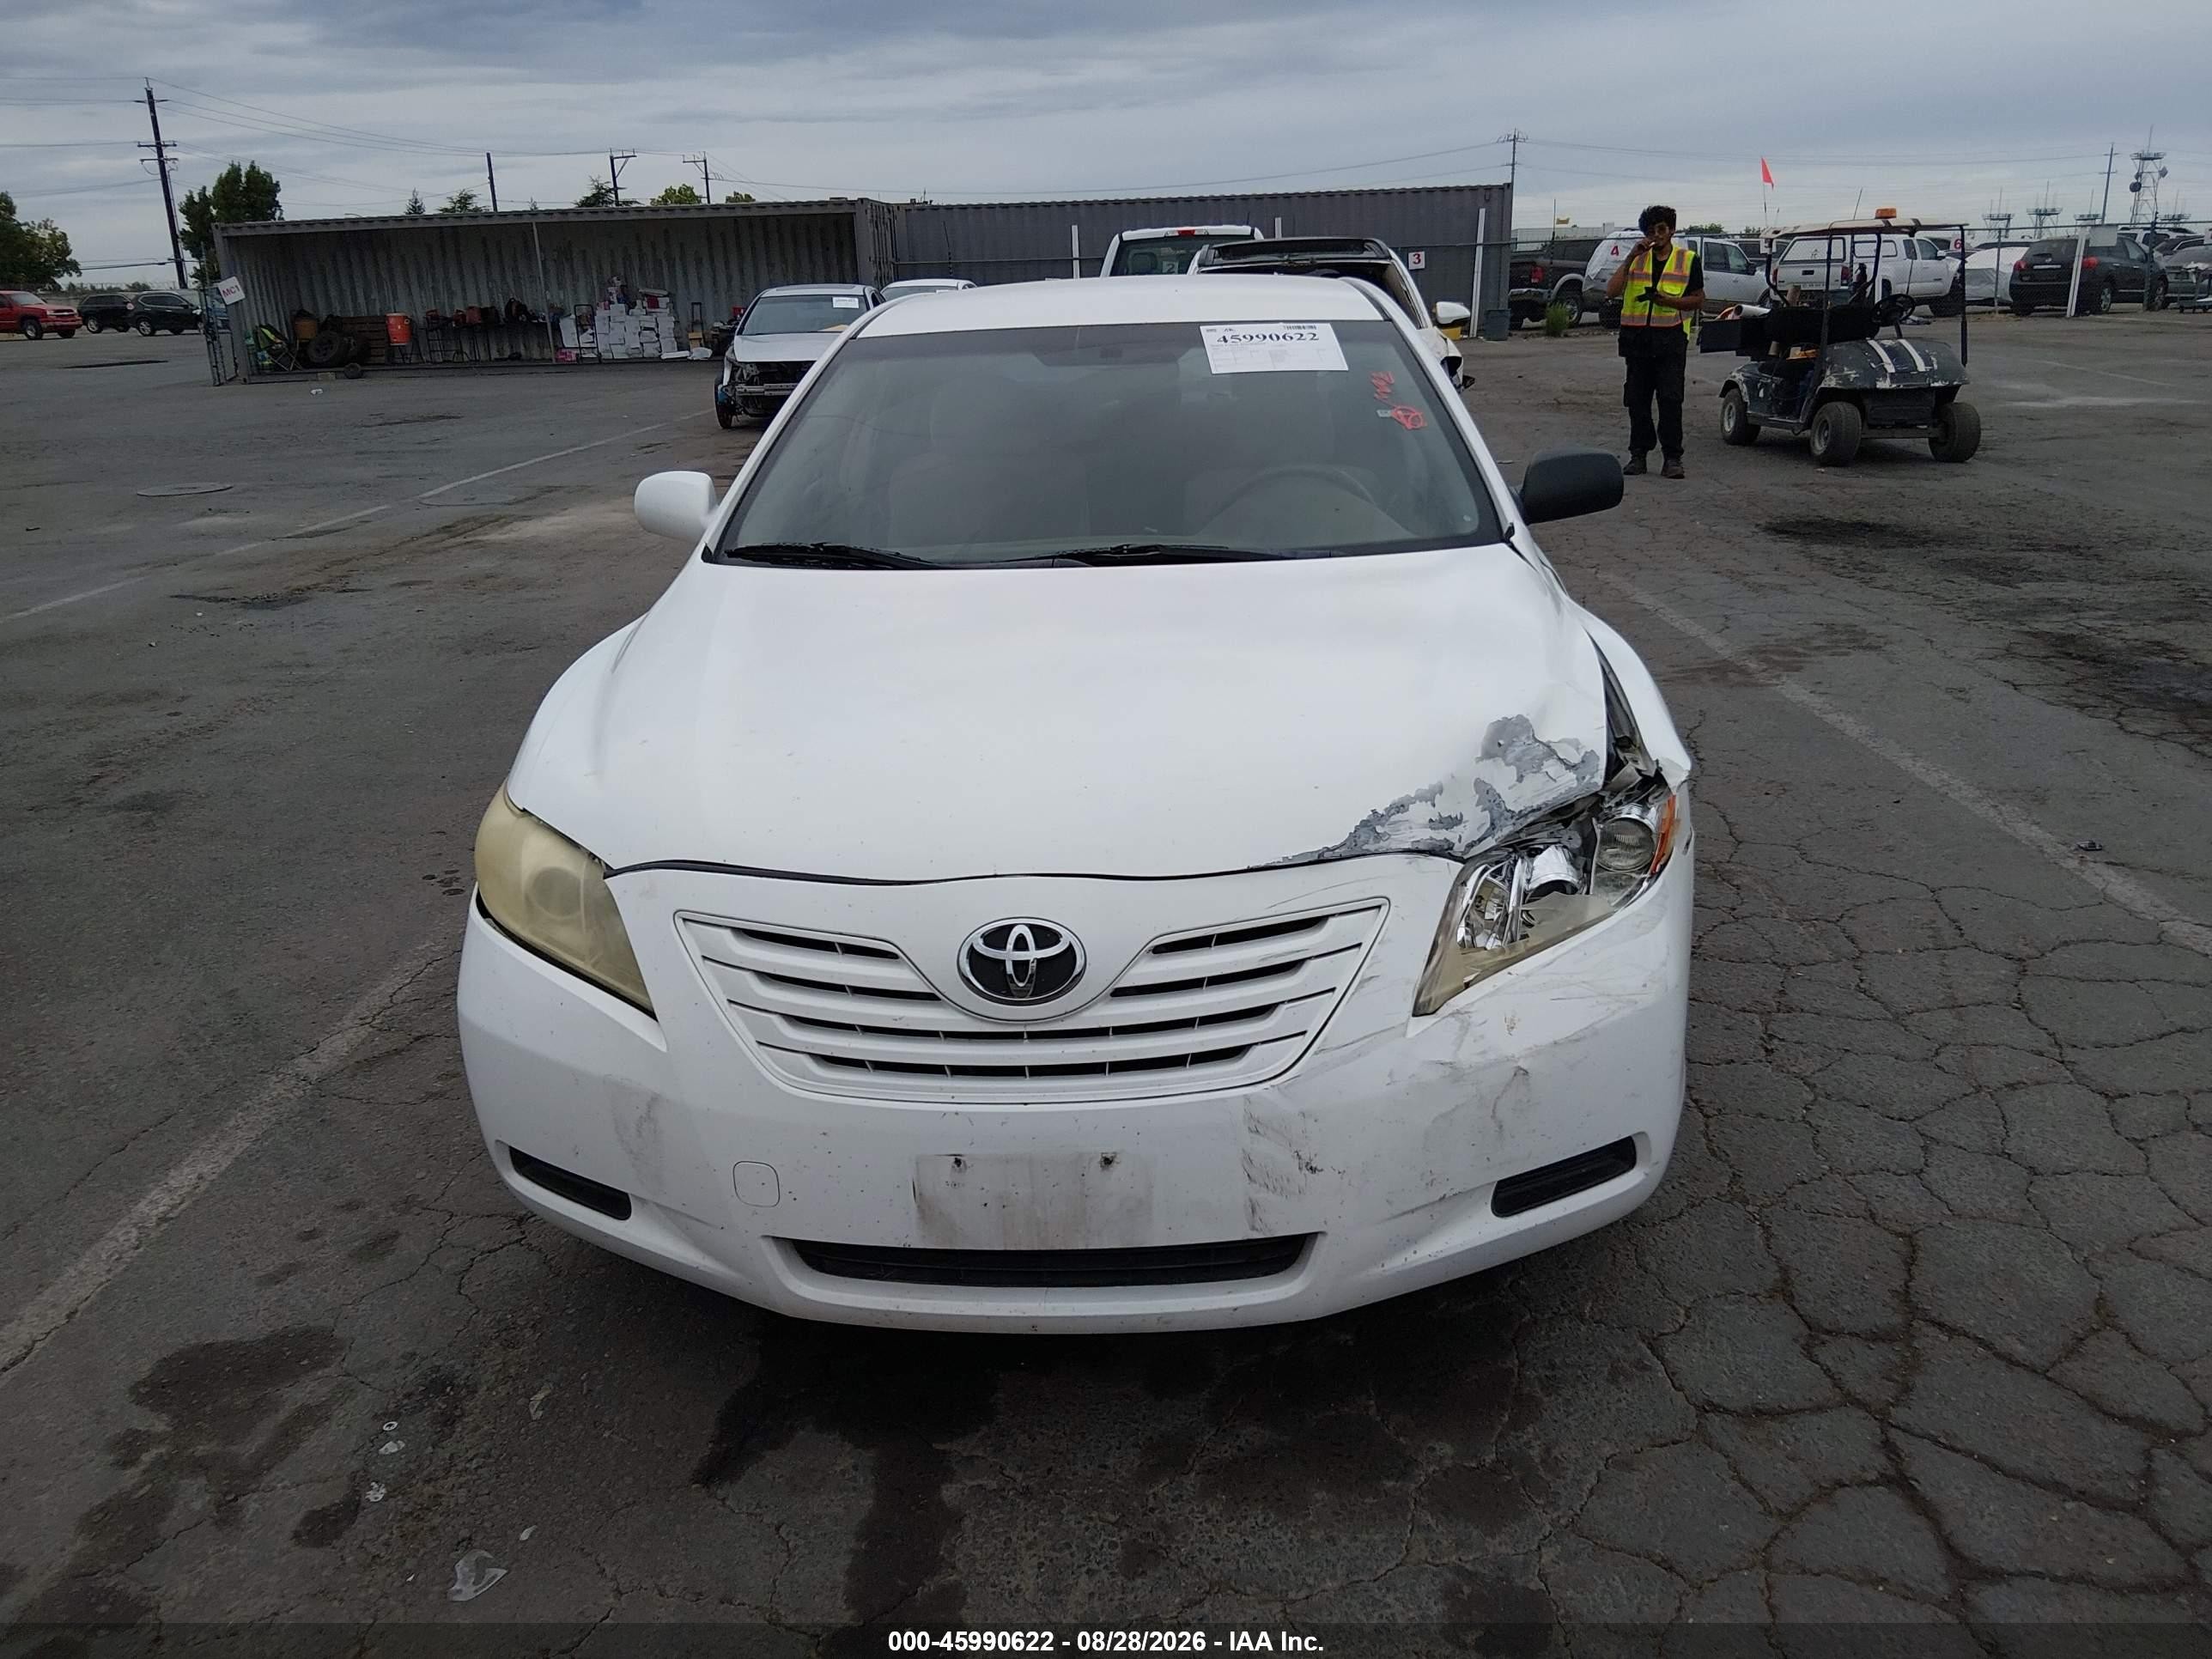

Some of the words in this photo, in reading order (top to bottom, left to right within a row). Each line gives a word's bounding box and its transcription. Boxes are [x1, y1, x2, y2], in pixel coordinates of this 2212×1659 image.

[1610, 245, 1620, 257] 4
[1413, 252, 1422, 264] 3
[1166, 263, 1176, 274] 2
[222, 285, 240, 297] MC1
[1217, 332, 1320, 343] 45990622
